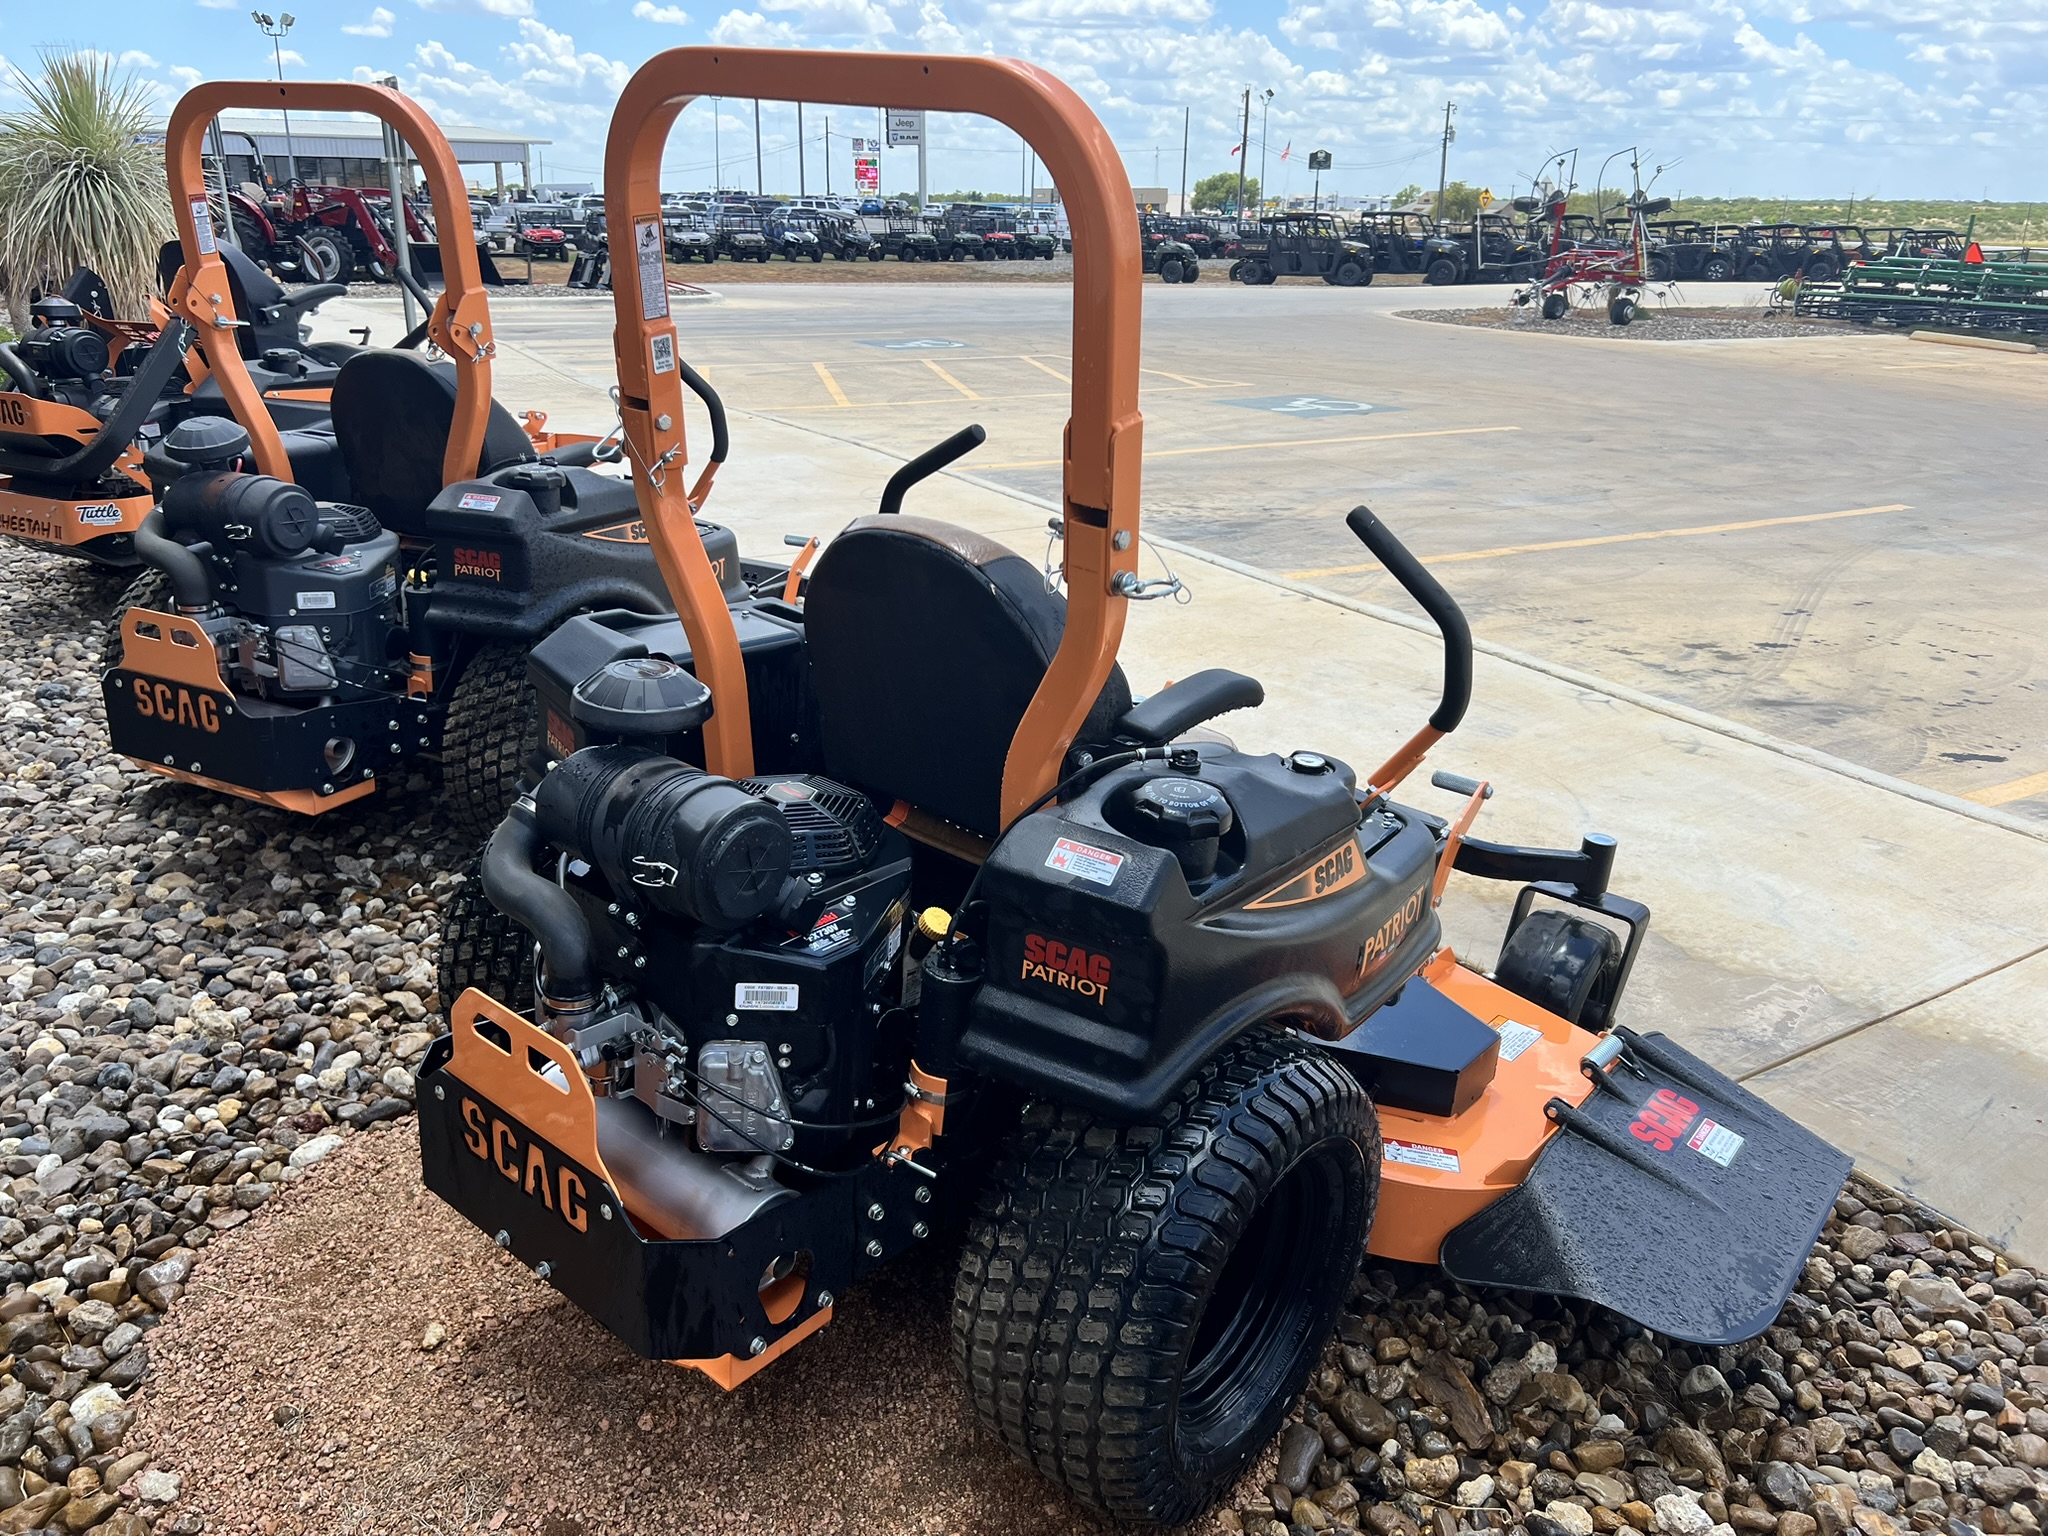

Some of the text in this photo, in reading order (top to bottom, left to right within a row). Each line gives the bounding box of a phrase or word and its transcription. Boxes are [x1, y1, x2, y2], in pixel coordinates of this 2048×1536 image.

[895, 118, 914, 128] Jeep
[0, 401, 24, 426] AG
[76, 504, 120, 522] Tuttle
[0, 514, 62, 540] HEETAH II
[630, 524, 647, 540] SC
[454, 548, 500, 568] SCAG
[454, 564, 500, 582] PATRIOT
[133, 678, 219, 734] SCAG
[547, 730, 572, 758] PATRIO
[1076, 847, 1112, 861] DANGER
[1314, 845, 1353, 894] SCAG
[808, 923, 839, 942] FX730V
[1360, 885, 1424, 976] PATRIOT
[1024, 934, 1111, 984] SCAG
[1022, 959, 1108, 1006] PATRIOT
[1628, 1089, 1700, 1151] SCAG
[1411, 1144, 1444, 1153] DANGER
[462, 1097, 588, 1233] SCAG
